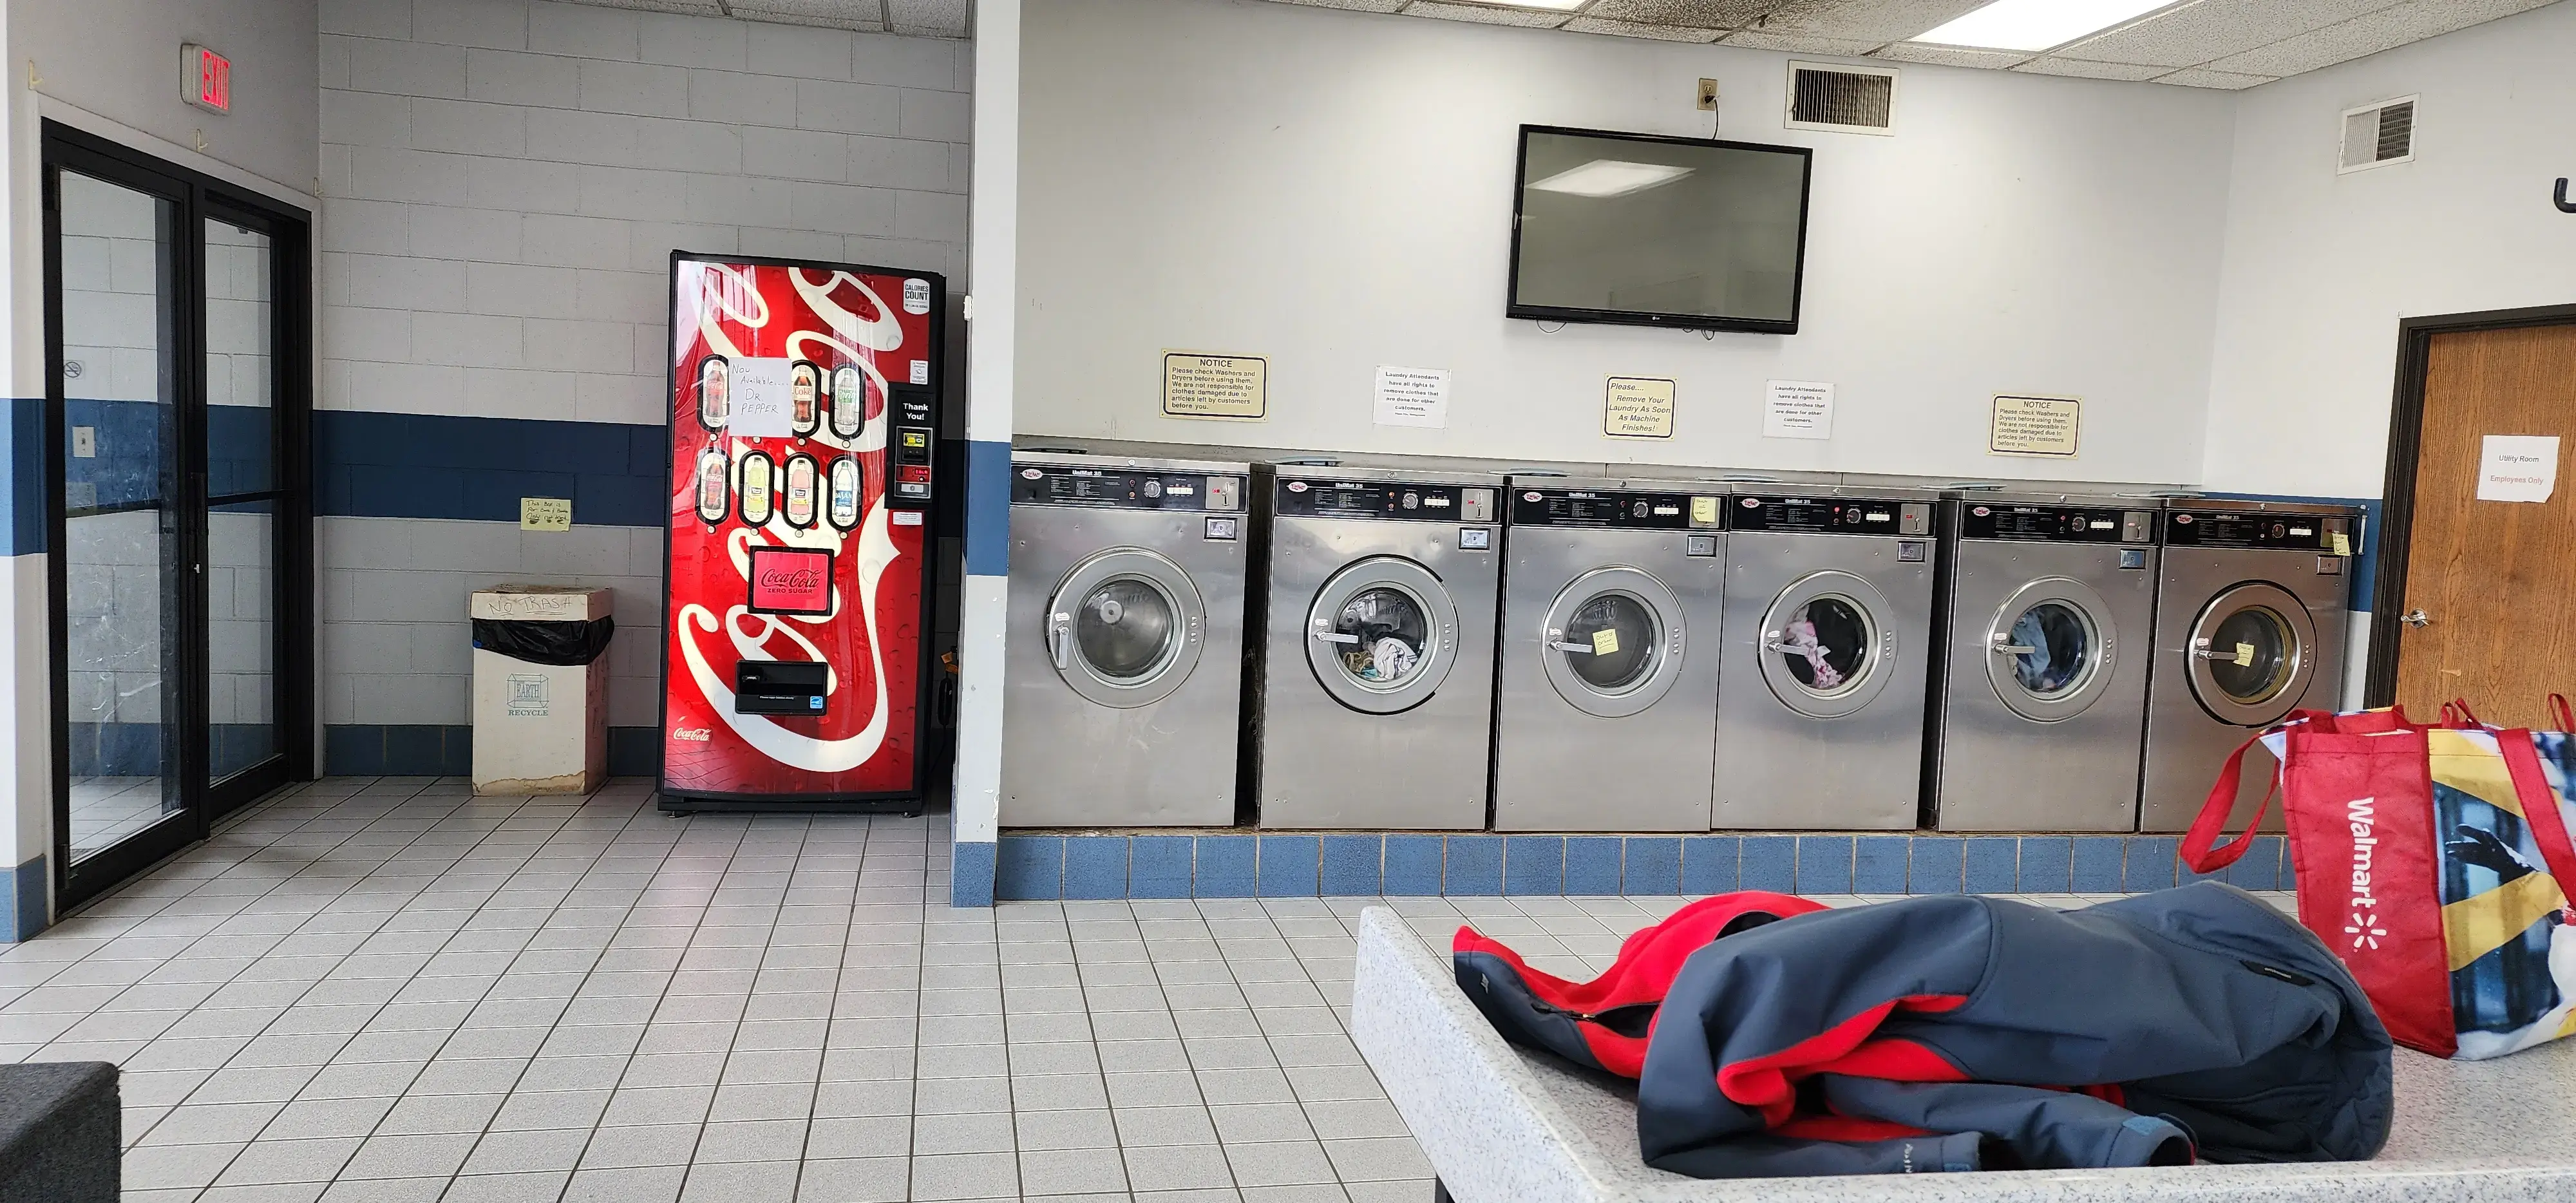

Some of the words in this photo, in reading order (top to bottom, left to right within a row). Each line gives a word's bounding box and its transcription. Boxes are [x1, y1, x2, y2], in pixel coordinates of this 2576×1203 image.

[202, 50, 230, 111] EXIT
[905, 291, 928, 300] COUNT
[795, 387, 811, 395] Coke
[741, 403, 779, 415] PEPPER
[903, 403, 929, 411] Thank
[1609, 404, 1638, 413] Laundry
[2499, 455, 2518, 463] Utility
[2490, 475, 2526, 484] Employees
[489, 601, 512, 614] NO
[518, 596, 571, 611] TRASH
[516, 683, 540, 698] EARTH
[2348, 797, 2378, 908] Walmart
